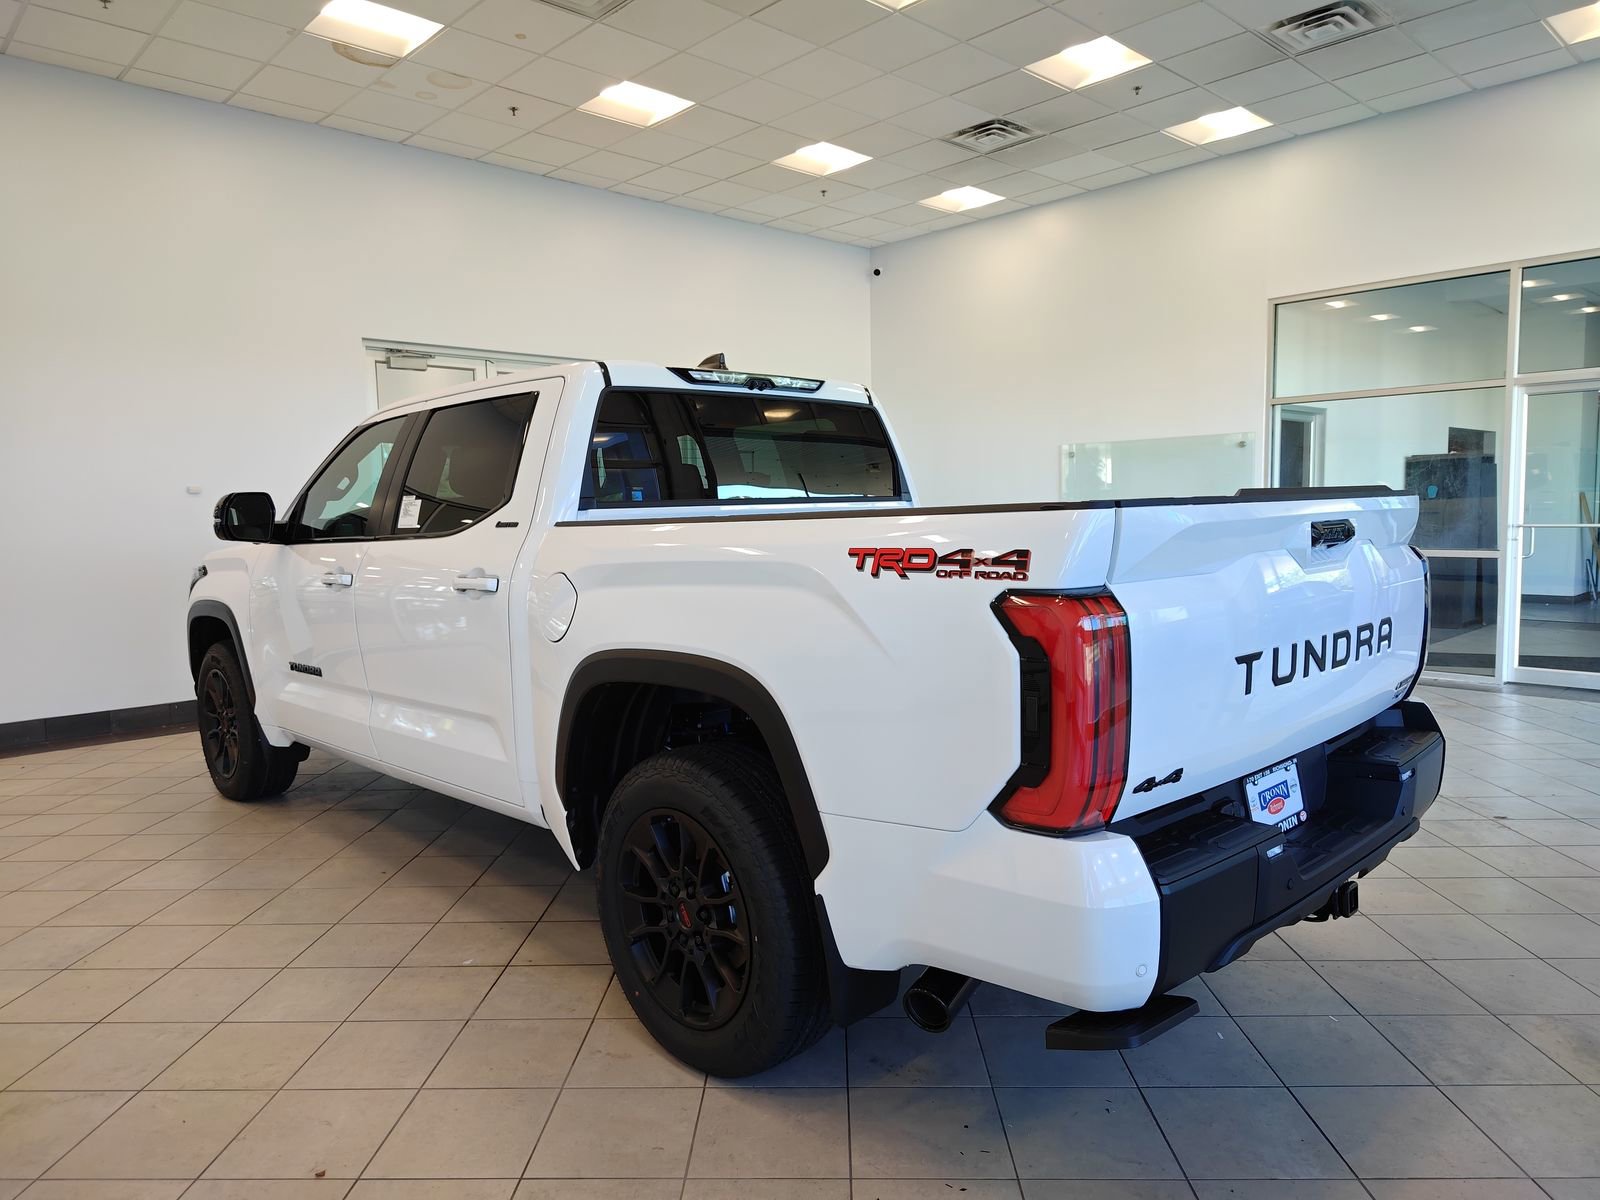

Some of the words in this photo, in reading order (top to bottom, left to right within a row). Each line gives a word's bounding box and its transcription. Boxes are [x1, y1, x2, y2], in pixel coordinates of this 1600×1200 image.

[848, 547, 938, 580] TRD
[936, 570, 972, 579] OFF
[974, 571, 1028, 581] ROAD
[1235, 616, 1393, 695] TUNDRA
[289, 661, 322, 677] TUNDRA
[1260, 782, 1289, 806] CRONIN
